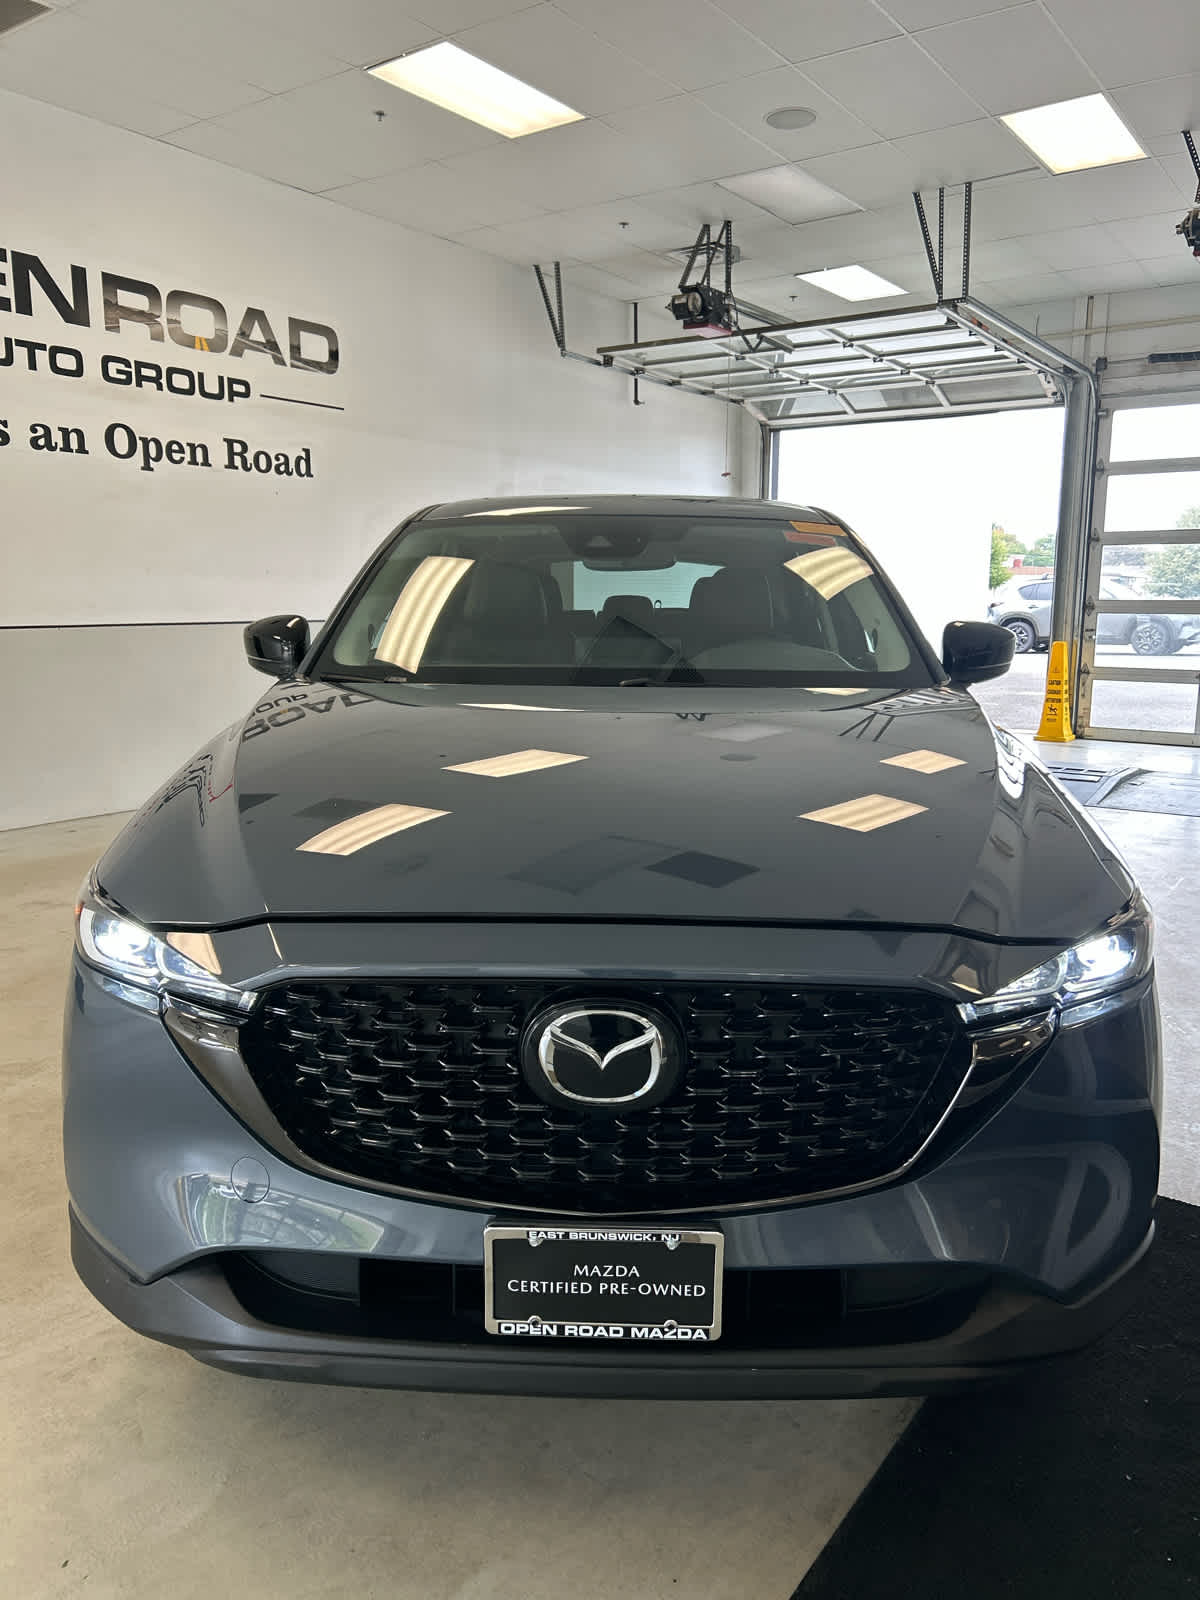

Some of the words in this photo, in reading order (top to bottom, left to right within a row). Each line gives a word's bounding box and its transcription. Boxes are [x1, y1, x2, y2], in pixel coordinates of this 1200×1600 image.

[0, 248, 90, 328] N
[101, 270, 340, 376] ROAD
[101, 354, 251, 402] GROUP
[29, 422, 89, 455] an
[104, 422, 212, 472] Open
[223, 436, 314, 478] Road
[528, 1231, 565, 1240] EAST
[569, 1231, 656, 1242] BRUNSWICK,
[660, 1233, 680, 1242] NJ
[573, 1264, 640, 1278] MAZDA
[507, 1279, 592, 1294] CERTIFIED
[599, 1282, 706, 1297] PRE-OWNED
[500, 1323, 557, 1336] OPEN
[564, 1325, 624, 1338] ROAD
[630, 1327, 708, 1340] MAZDA
